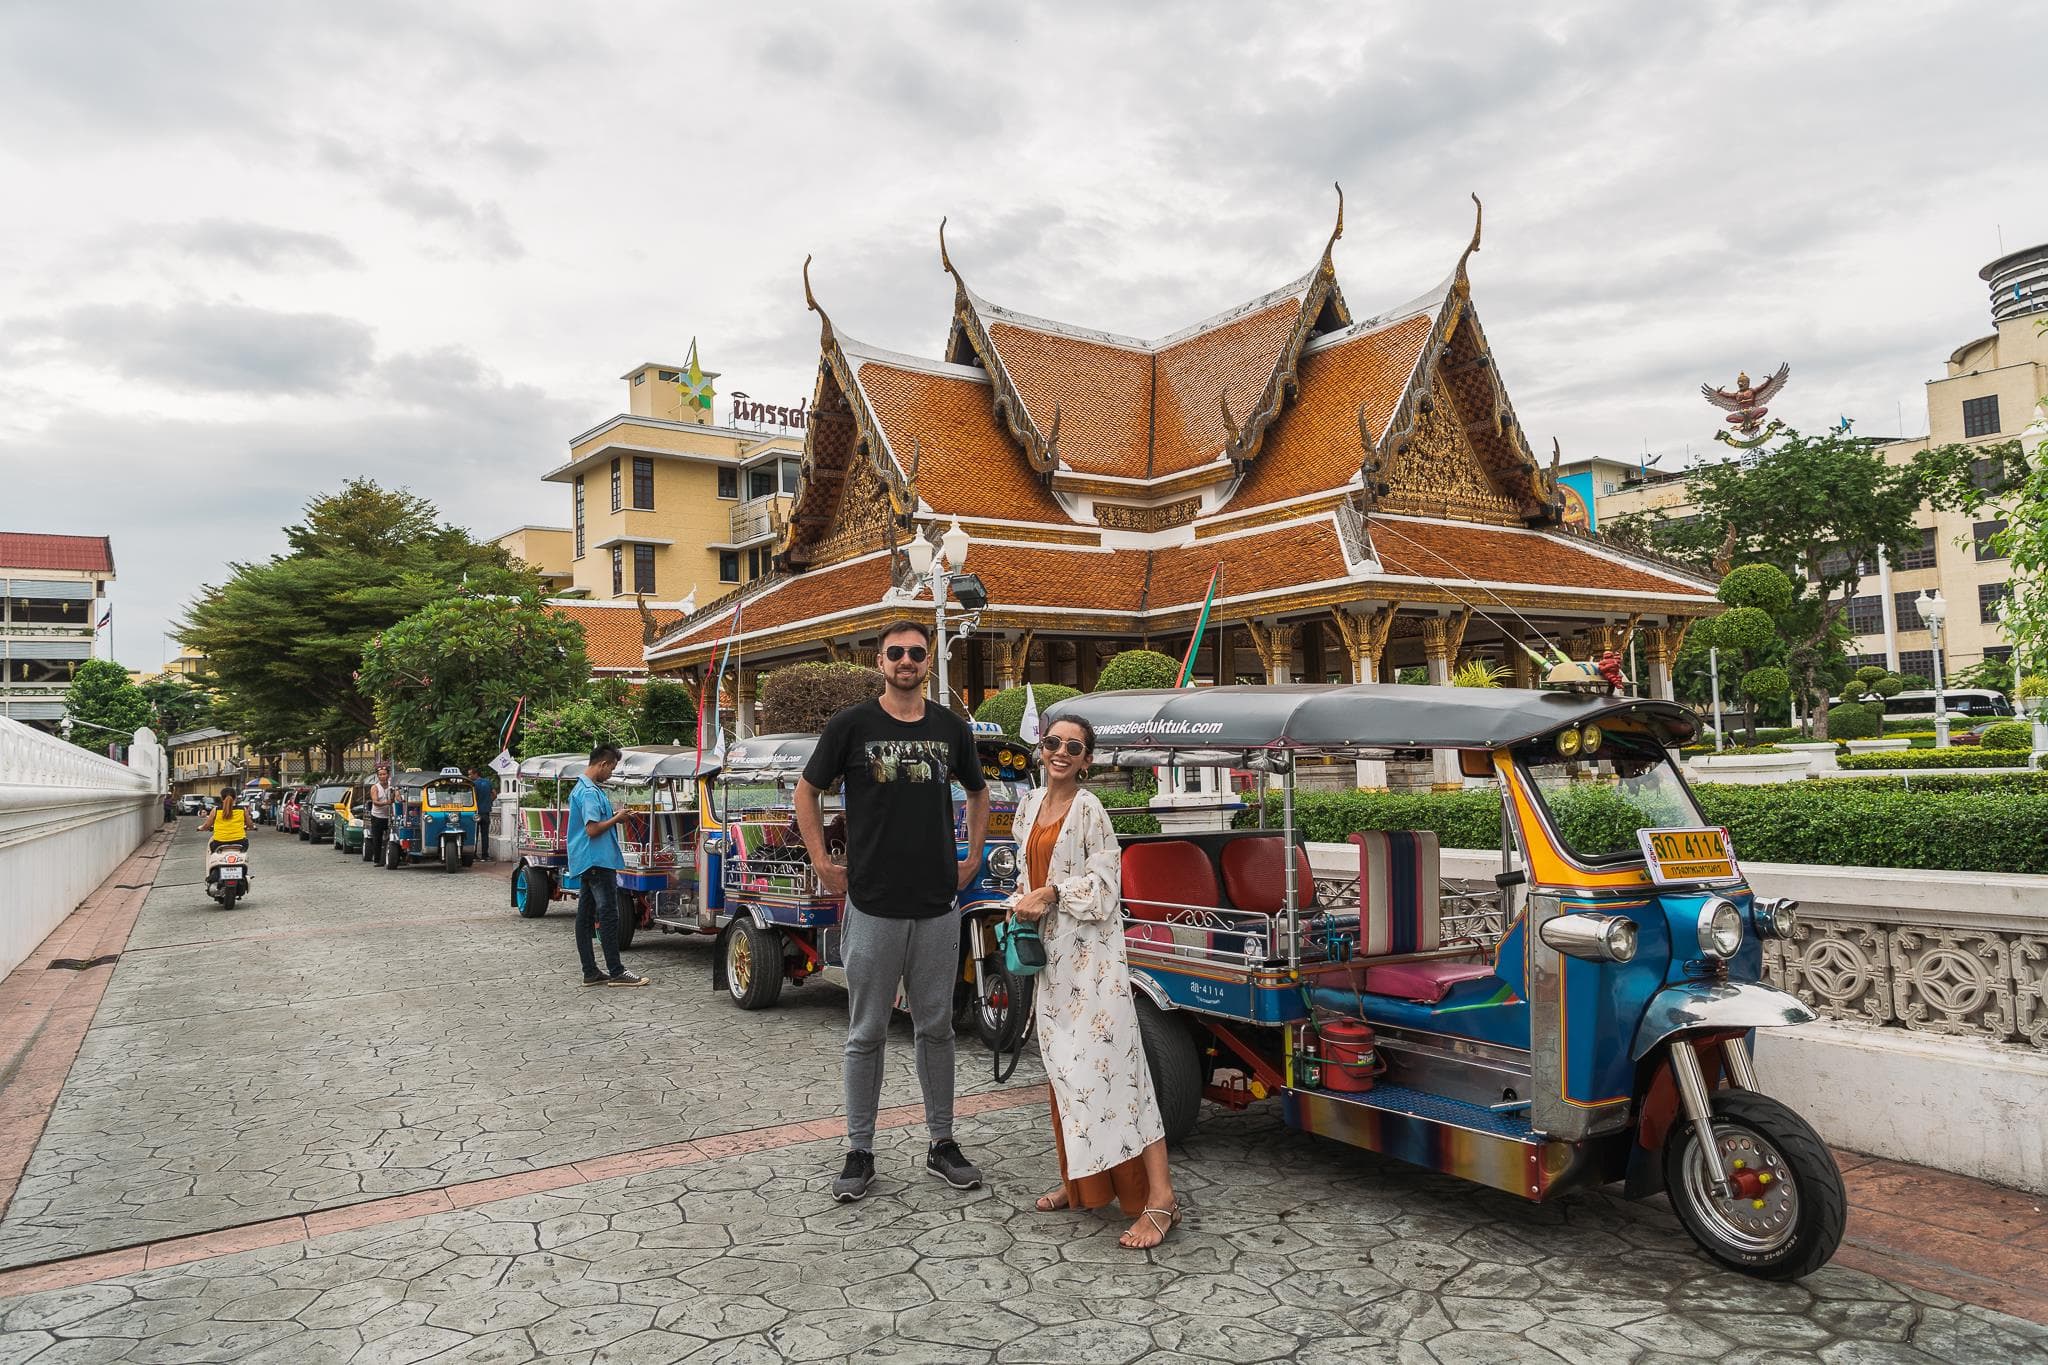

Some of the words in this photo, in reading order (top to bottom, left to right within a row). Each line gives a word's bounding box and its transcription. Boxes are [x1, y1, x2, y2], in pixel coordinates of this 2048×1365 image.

[730, 391, 808, 429] นิทรรศ
[1685, 834, 1724, 858] 4114
